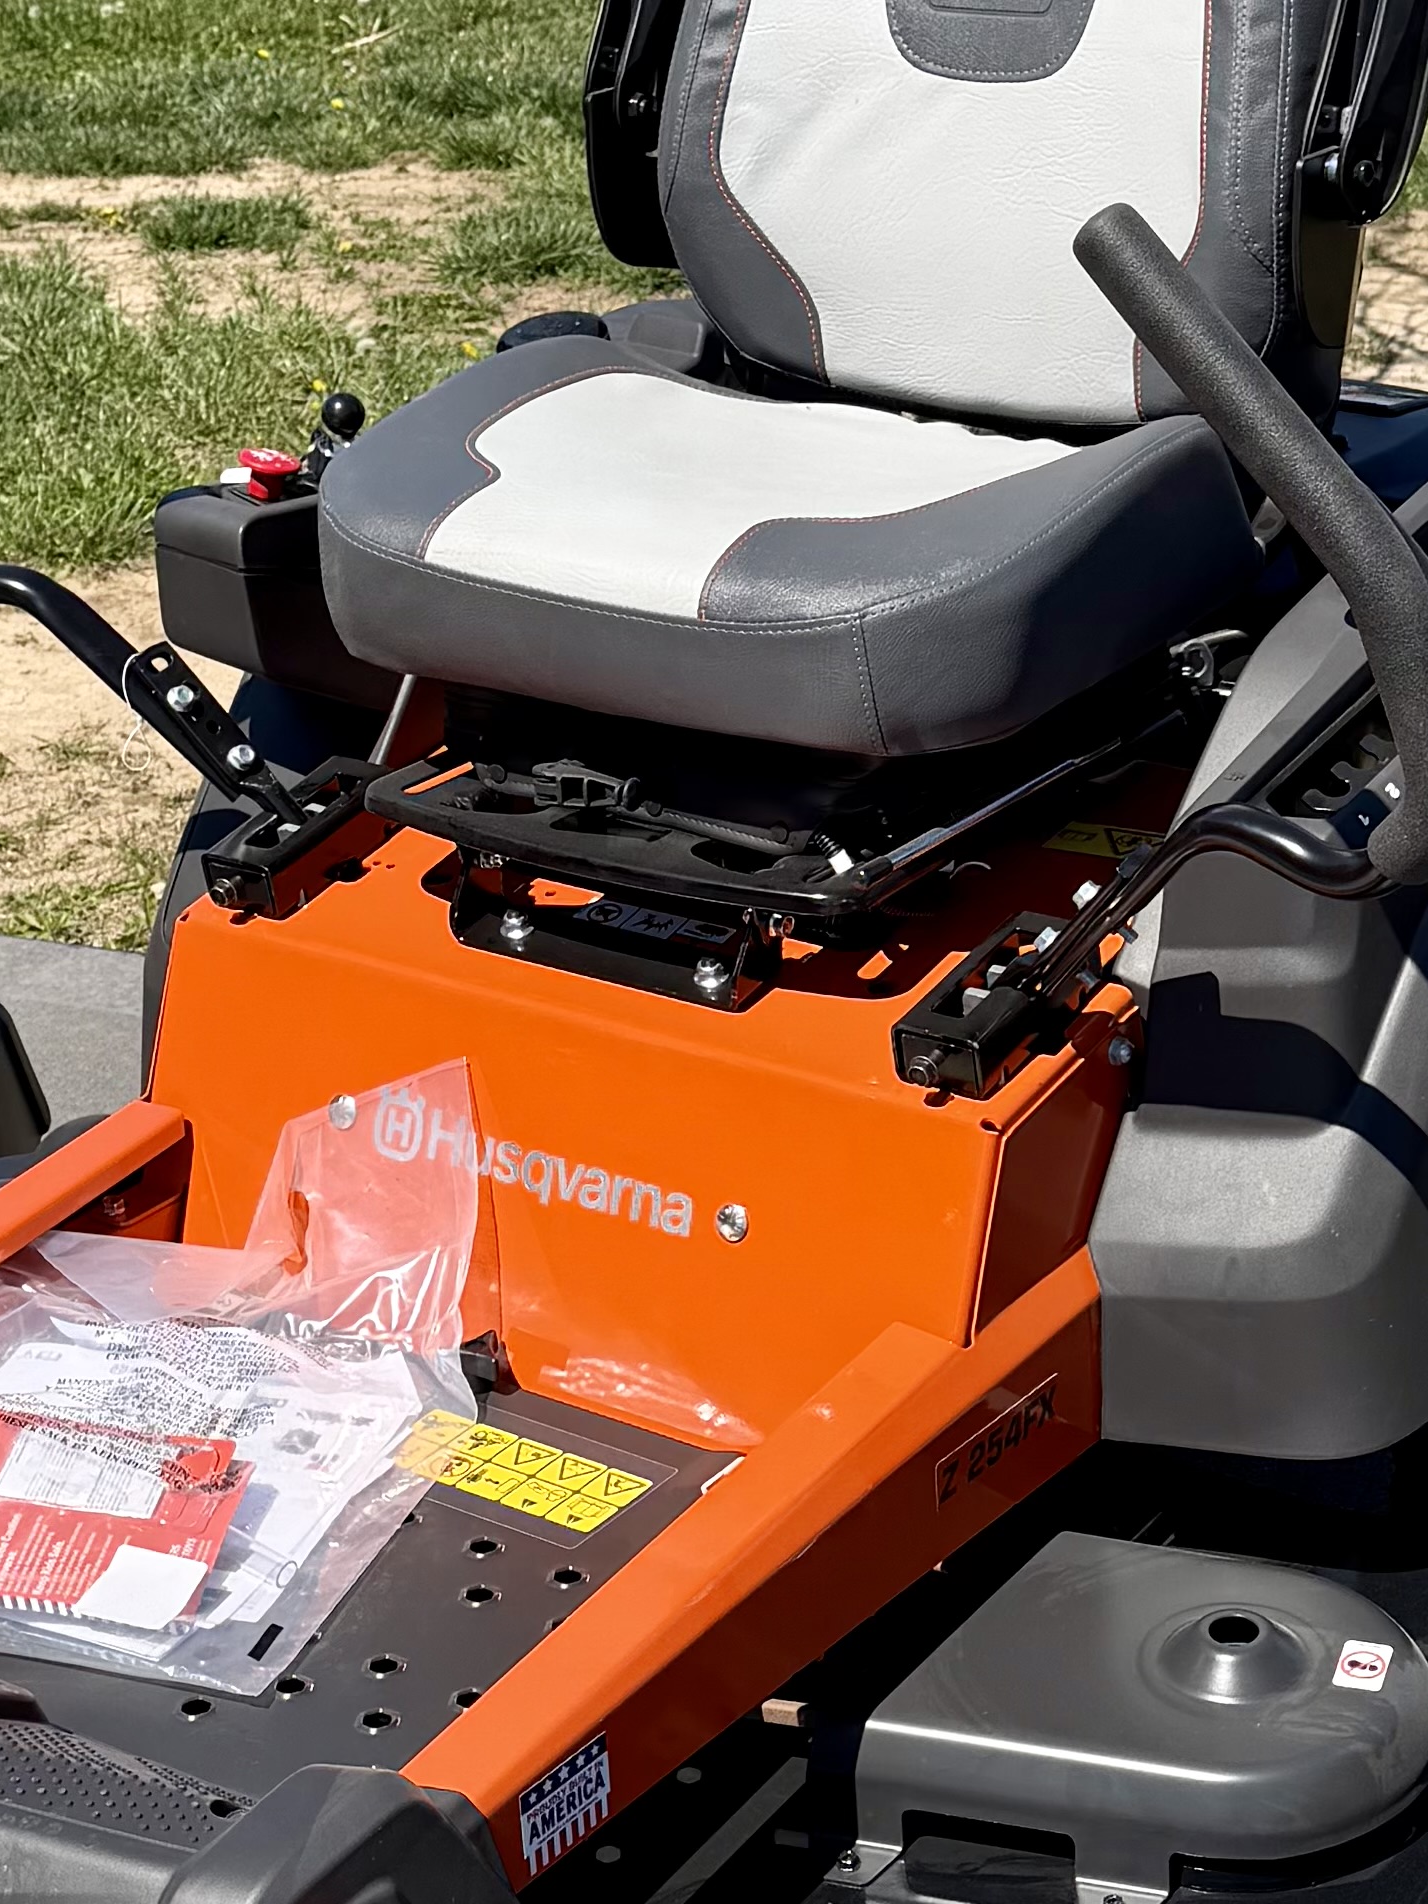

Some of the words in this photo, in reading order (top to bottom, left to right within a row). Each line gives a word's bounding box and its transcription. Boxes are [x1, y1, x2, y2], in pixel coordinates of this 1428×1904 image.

[427, 1108, 693, 1237] Husqvarna
[39, 1427, 68, 1445] SACK
[91, 1446, 120, 1462] KEIN
[939, 1459, 960, 1505] Z
[966, 1384, 1057, 1484] 254FX
[527, 1786, 567, 1824] PROUDLY
[529, 1769, 606, 1846] AMERICA
